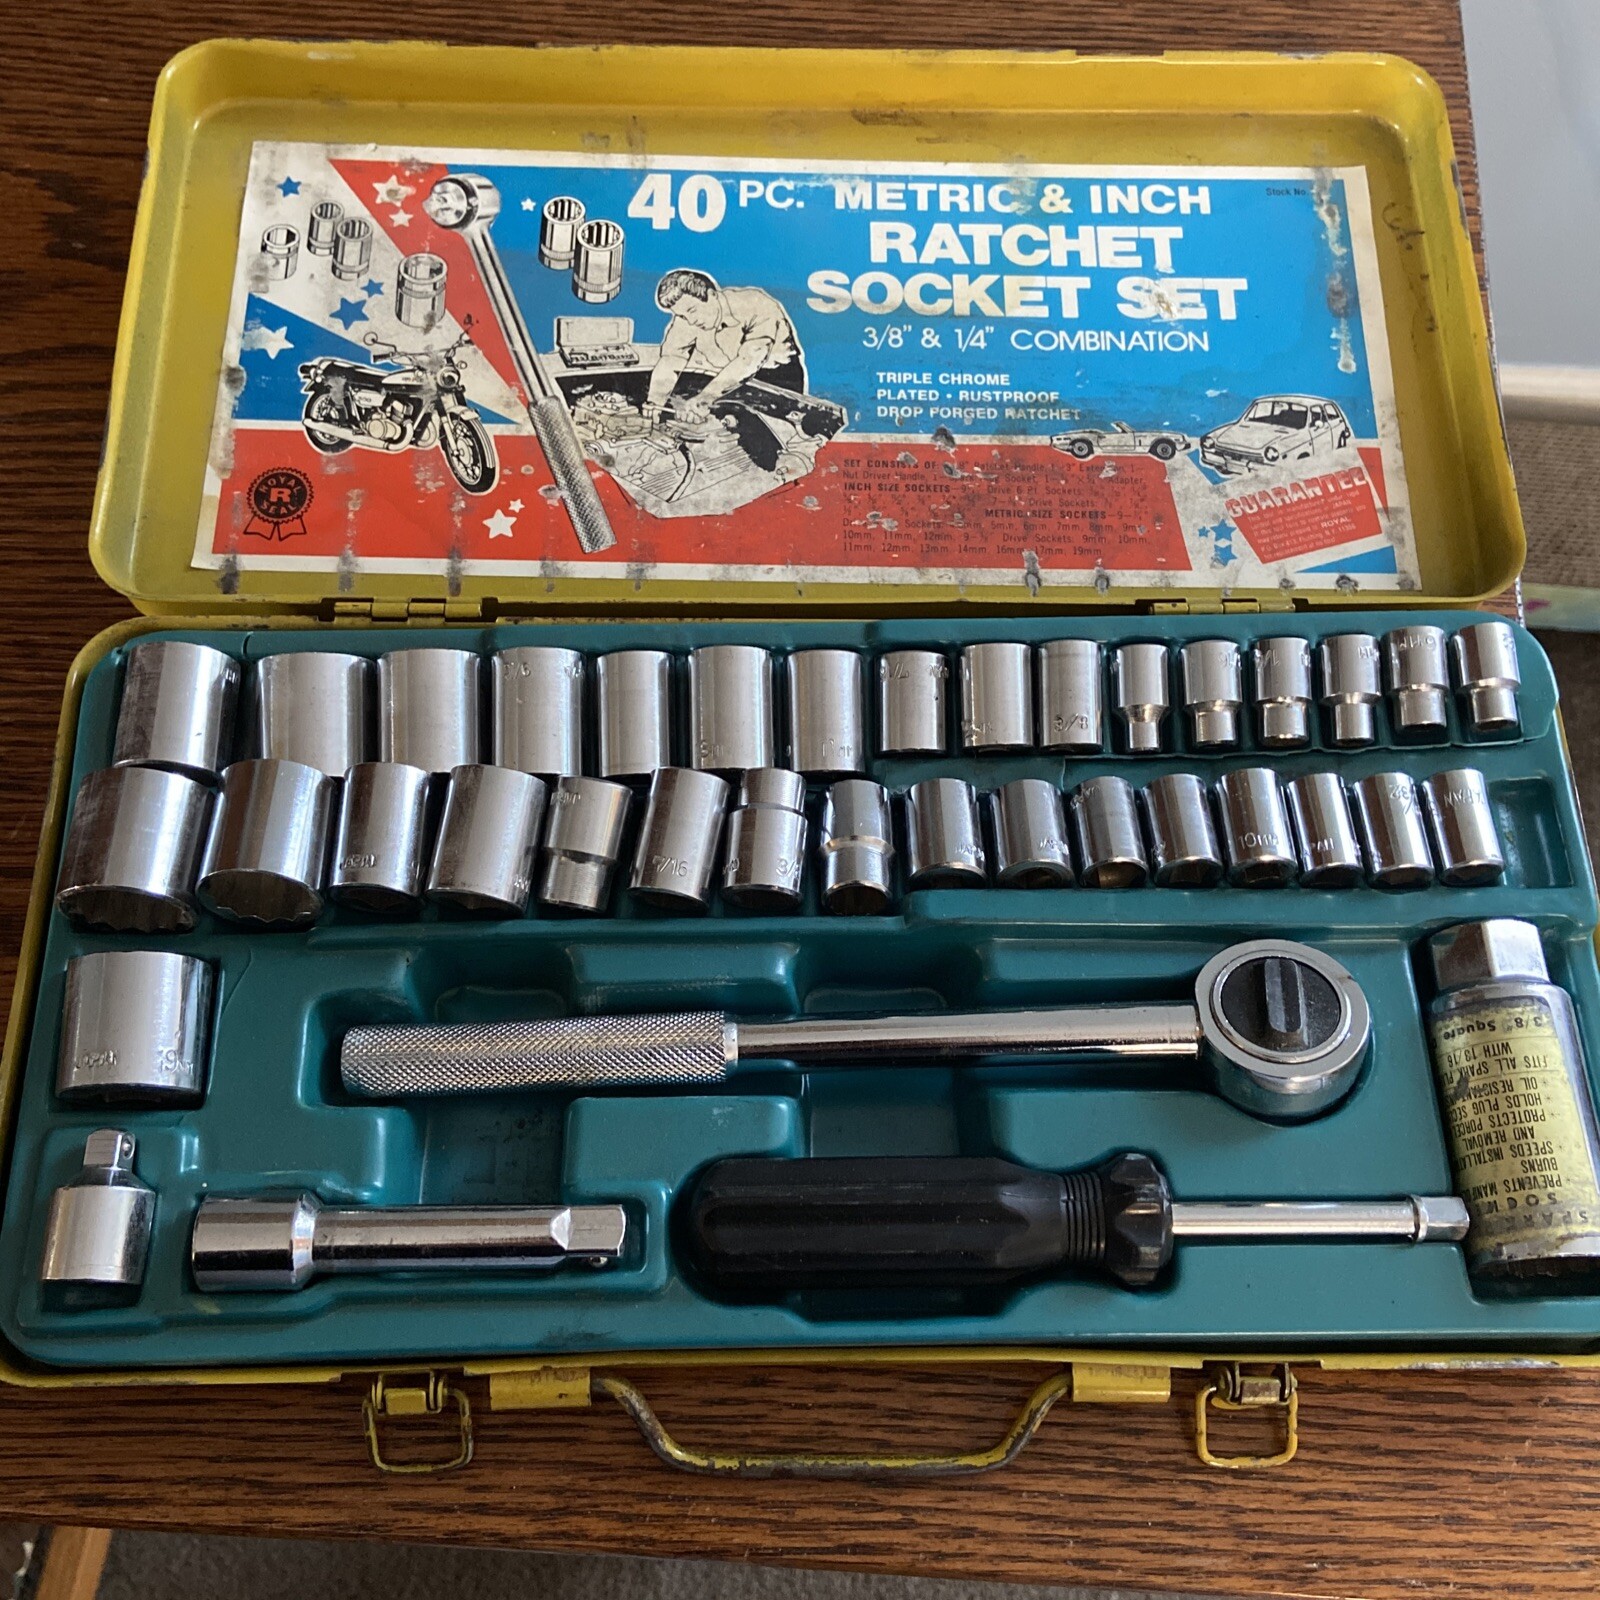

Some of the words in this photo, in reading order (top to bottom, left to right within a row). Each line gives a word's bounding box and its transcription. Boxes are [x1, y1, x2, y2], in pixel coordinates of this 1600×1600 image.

[1265, 187, 1292, 196] Stock
[627, 174, 727, 233] 40
[739, 180, 805, 210] PC.
[834, 182, 1026, 214] METRIC
[1039, 183, 1074, 214] &
[1090, 184, 1211, 215] INCH
[869, 221, 1184, 271] RATCHET
[806, 270, 1092, 319] SOCKET
[1116, 276, 1249, 322] SET
[920, 327, 942, 349] &
[1010, 328, 1211, 353] COMBINATION
[876, 371, 933, 385] TRIPLE
[938, 372, 1011, 386] CHROME
[876, 388, 940, 402] PLATED
[958, 390, 1060, 403] RUSTPROOF
[876, 405, 924, 419] DROP
[929, 407, 998, 420] FORGED
[1004, 408, 1082, 421] RATCHET
[843, 459, 861, 468] SET
[259, 475, 302, 494] ROYAL
[844, 482, 872, 491] INCH
[877, 483, 899, 492] SIZE
[1223, 466, 1368, 518] GUARANTEE
[269, 487, 292, 503] R
[260, 500, 297, 514] SEAL
[984, 509, 1023, 519] METRIC
[1031, 510, 1053, 519] SIZE
[1443, 1019, 1497, 1041] Square
[1482, 1041, 1513, 1059] WITH
[1495, 1056, 1517, 1072] ALL
[1523, 1054, 1549, 1069] FITS
[1520, 1076, 1538, 1090] OIL
[1472, 1098, 1500, 1116] PLUG
[1506, 1092, 1543, 1109] HOLDS
[1488, 1108, 1547, 1129] PROTECTS
[1461, 1129, 1507, 1152] REMOVAL
[1512, 1125, 1536, 1141] AND
[1509, 1140, 1554, 1159] SPEEDS
[1520, 1157, 1559, 1174] BURNS
[1503, 1173, 1563, 1194] PREVENTS
